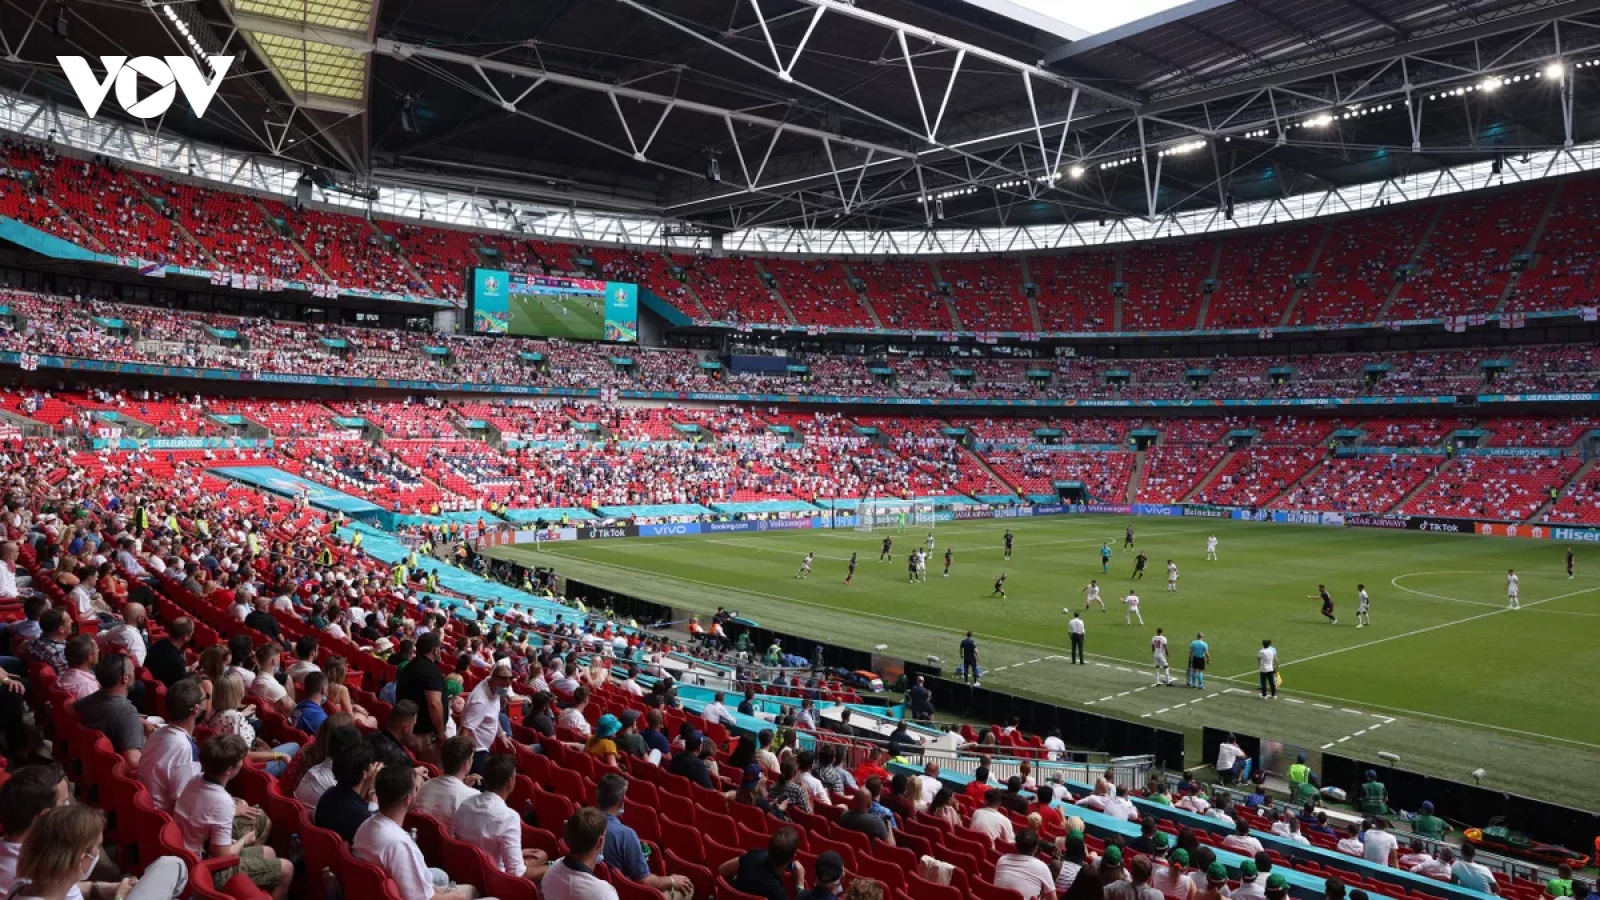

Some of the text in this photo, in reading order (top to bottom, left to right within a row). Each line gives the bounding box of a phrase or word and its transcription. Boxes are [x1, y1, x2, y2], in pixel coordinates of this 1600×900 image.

[1087, 504, 1132, 513] Volkswagen
[1184, 507, 1222, 517] Heineken
[711, 522, 748, 531] Booking.com
[1350, 516, 1407, 528] ATAR AIRWAYS
[1430, 523, 1459, 532] TikTok
[534, 529, 561, 541] FedEx
[598, 528, 625, 538] TikTok
